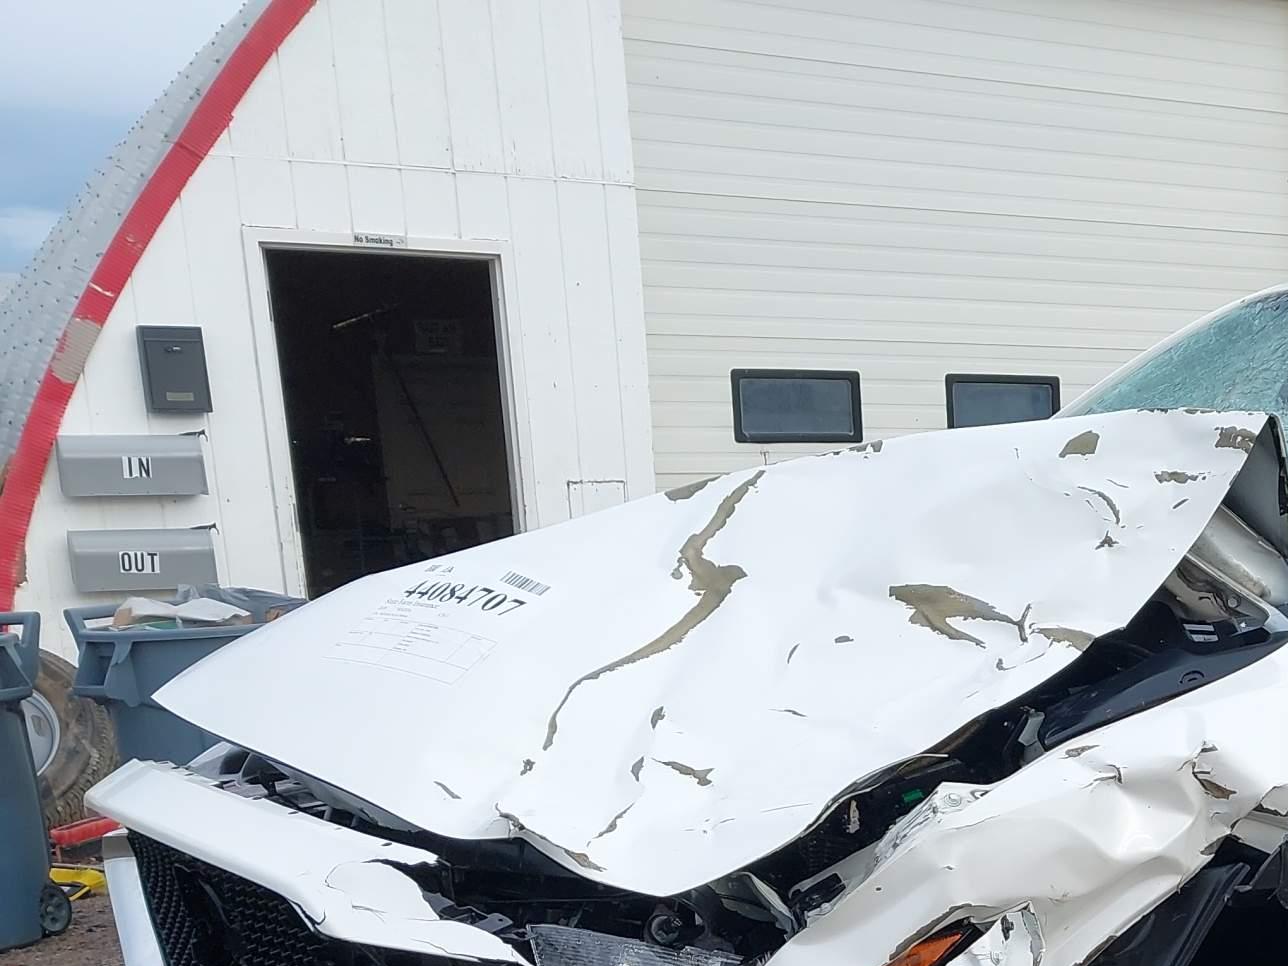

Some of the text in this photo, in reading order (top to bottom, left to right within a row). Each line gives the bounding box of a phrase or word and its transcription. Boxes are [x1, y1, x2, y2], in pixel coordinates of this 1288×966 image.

[353, 235, 393, 247] No Smoking
[127, 456, 151, 479] IN
[120, 552, 158, 573] OUT
[403, 580, 527, 616] 44084707
